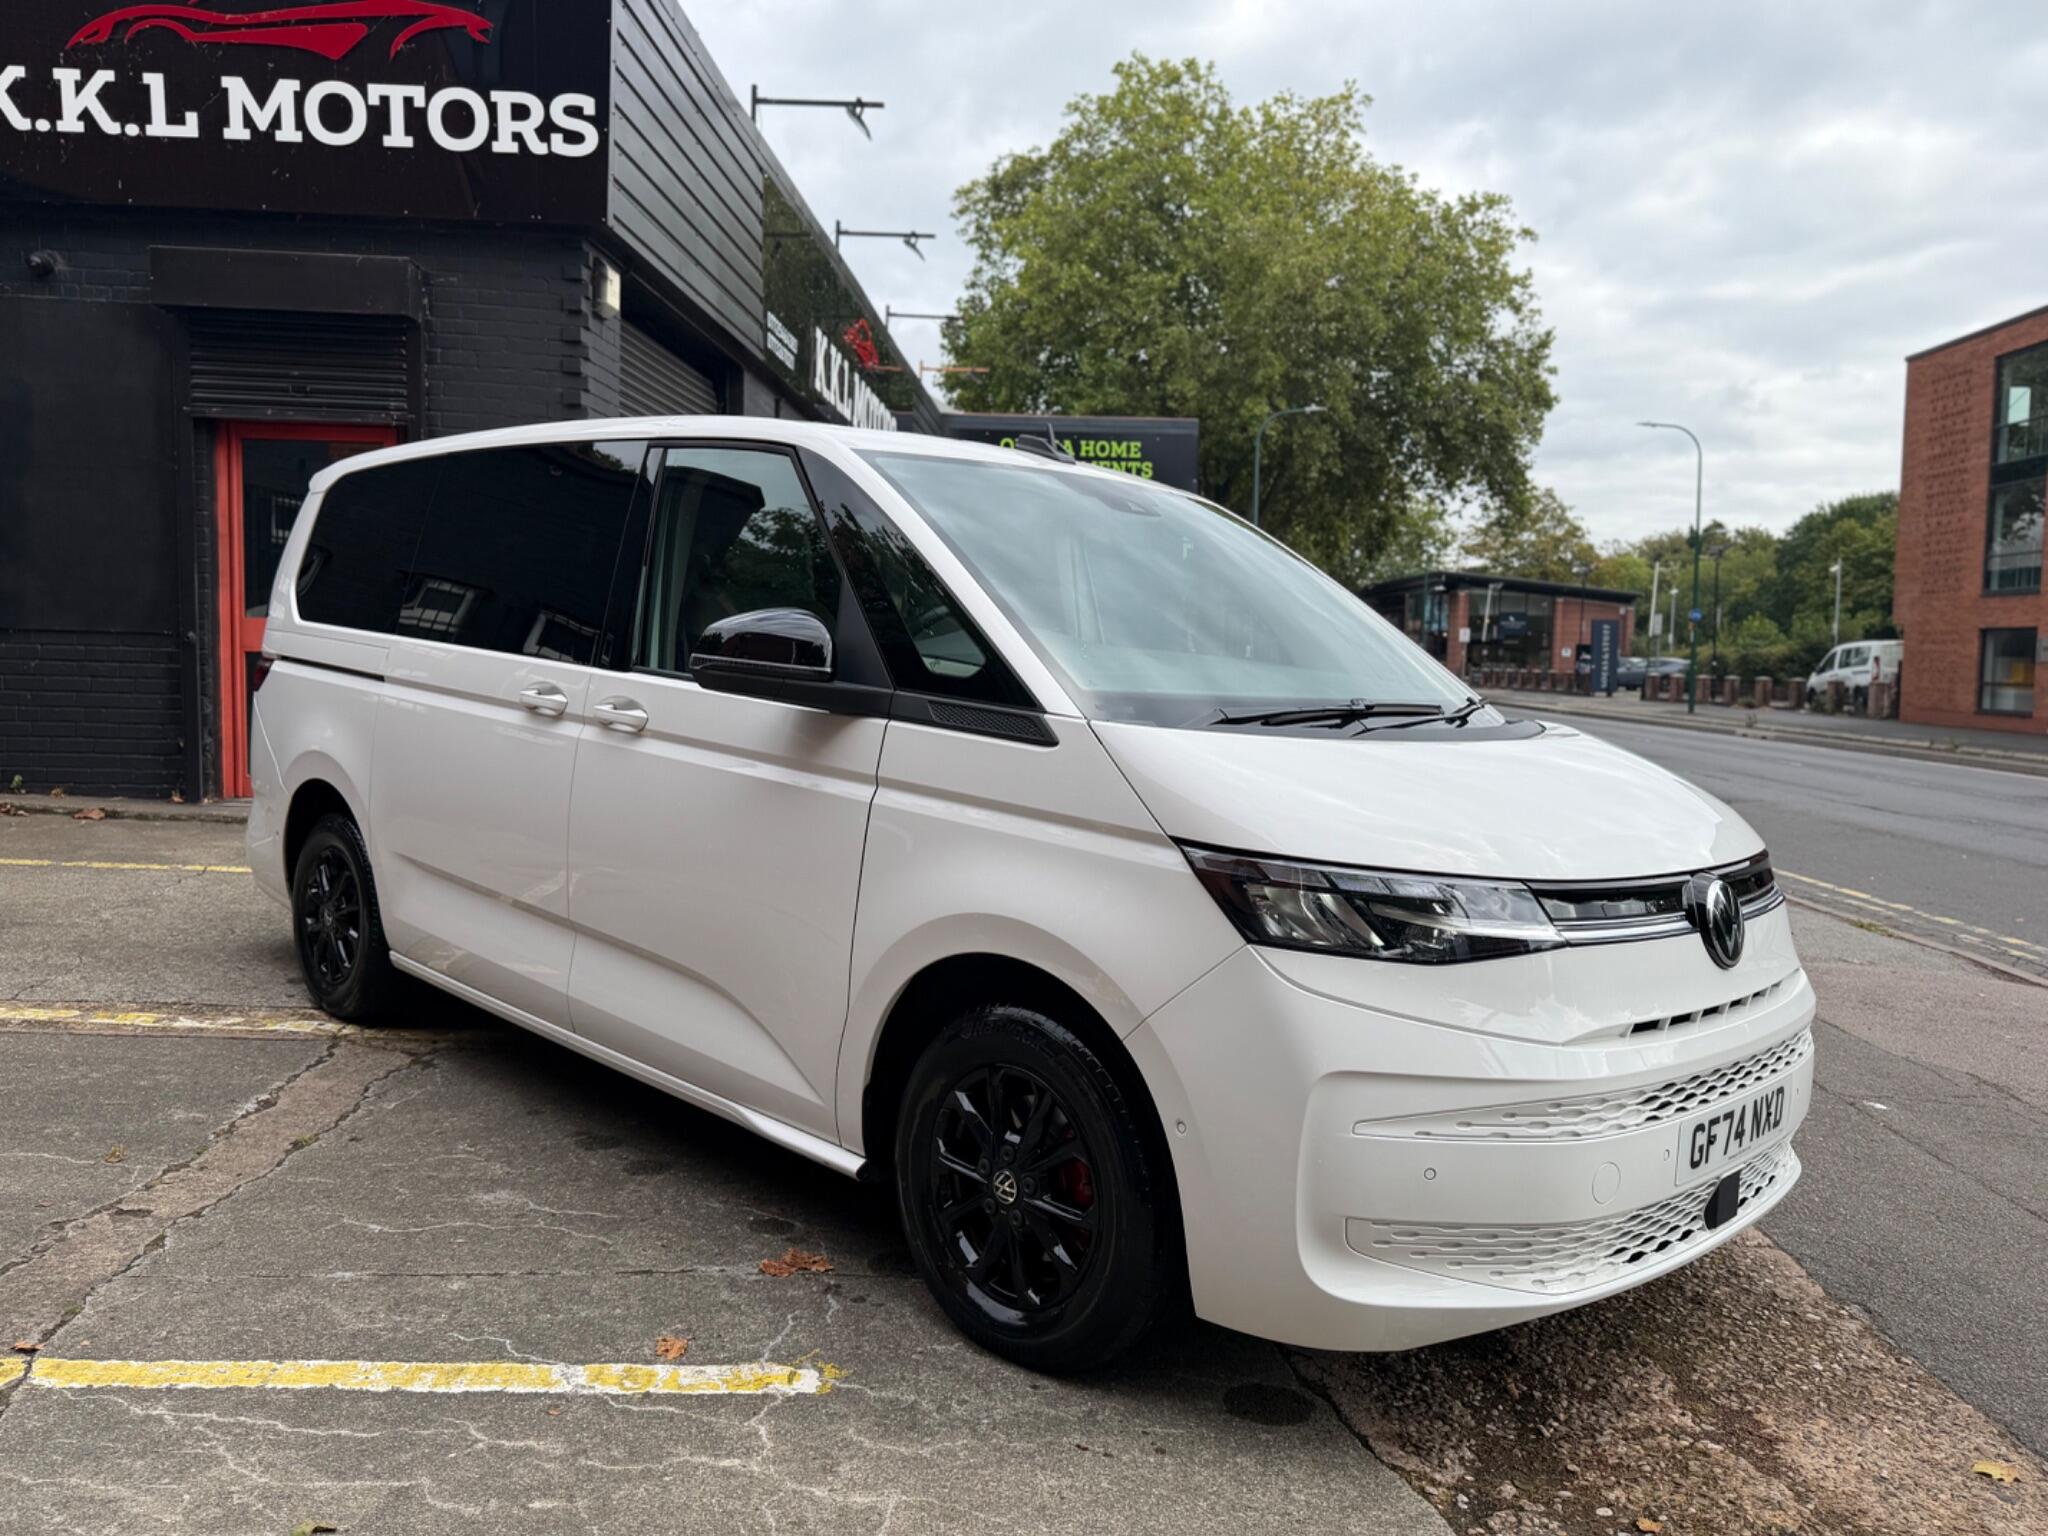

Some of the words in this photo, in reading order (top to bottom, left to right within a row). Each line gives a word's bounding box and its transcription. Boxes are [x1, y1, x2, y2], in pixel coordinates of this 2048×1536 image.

[220, 75, 600, 157] MOTORS
[1079, 440, 1142, 459] HOME
[1690, 1104, 1746, 1170] GF74
[1750, 1086, 1785, 1142] NXD
